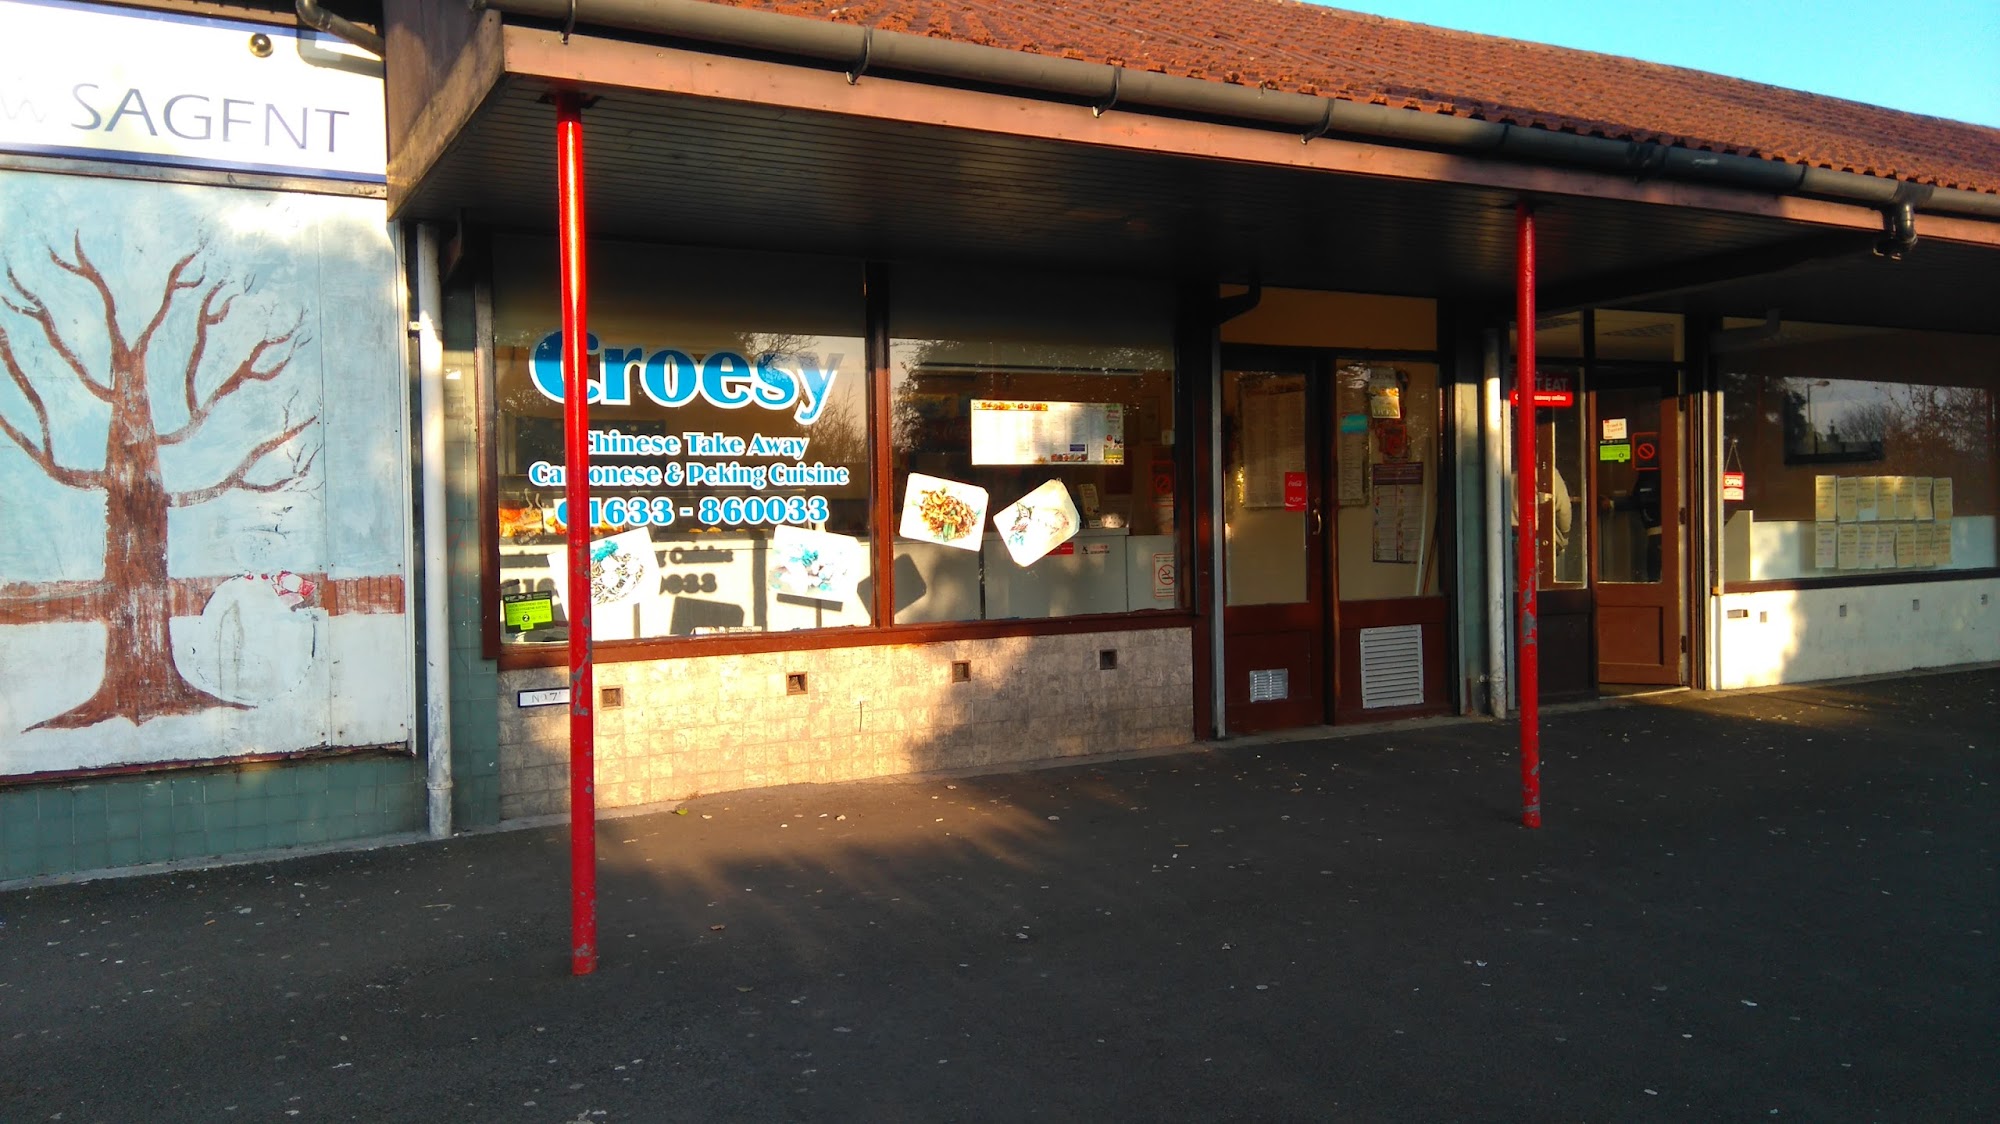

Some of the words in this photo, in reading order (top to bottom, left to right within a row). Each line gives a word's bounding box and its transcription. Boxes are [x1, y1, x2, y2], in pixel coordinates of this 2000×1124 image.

[528, 329, 845, 426] Croesy
[682, 432, 746, 456] Take
[746, 433, 810, 460] Away
[529, 461, 662, 487] Caonese
[664, 461, 685, 487] &
[686, 461, 767, 490] Peking
[768, 461, 849, 486] Cuisine
[698, 496, 829, 525] 860033
